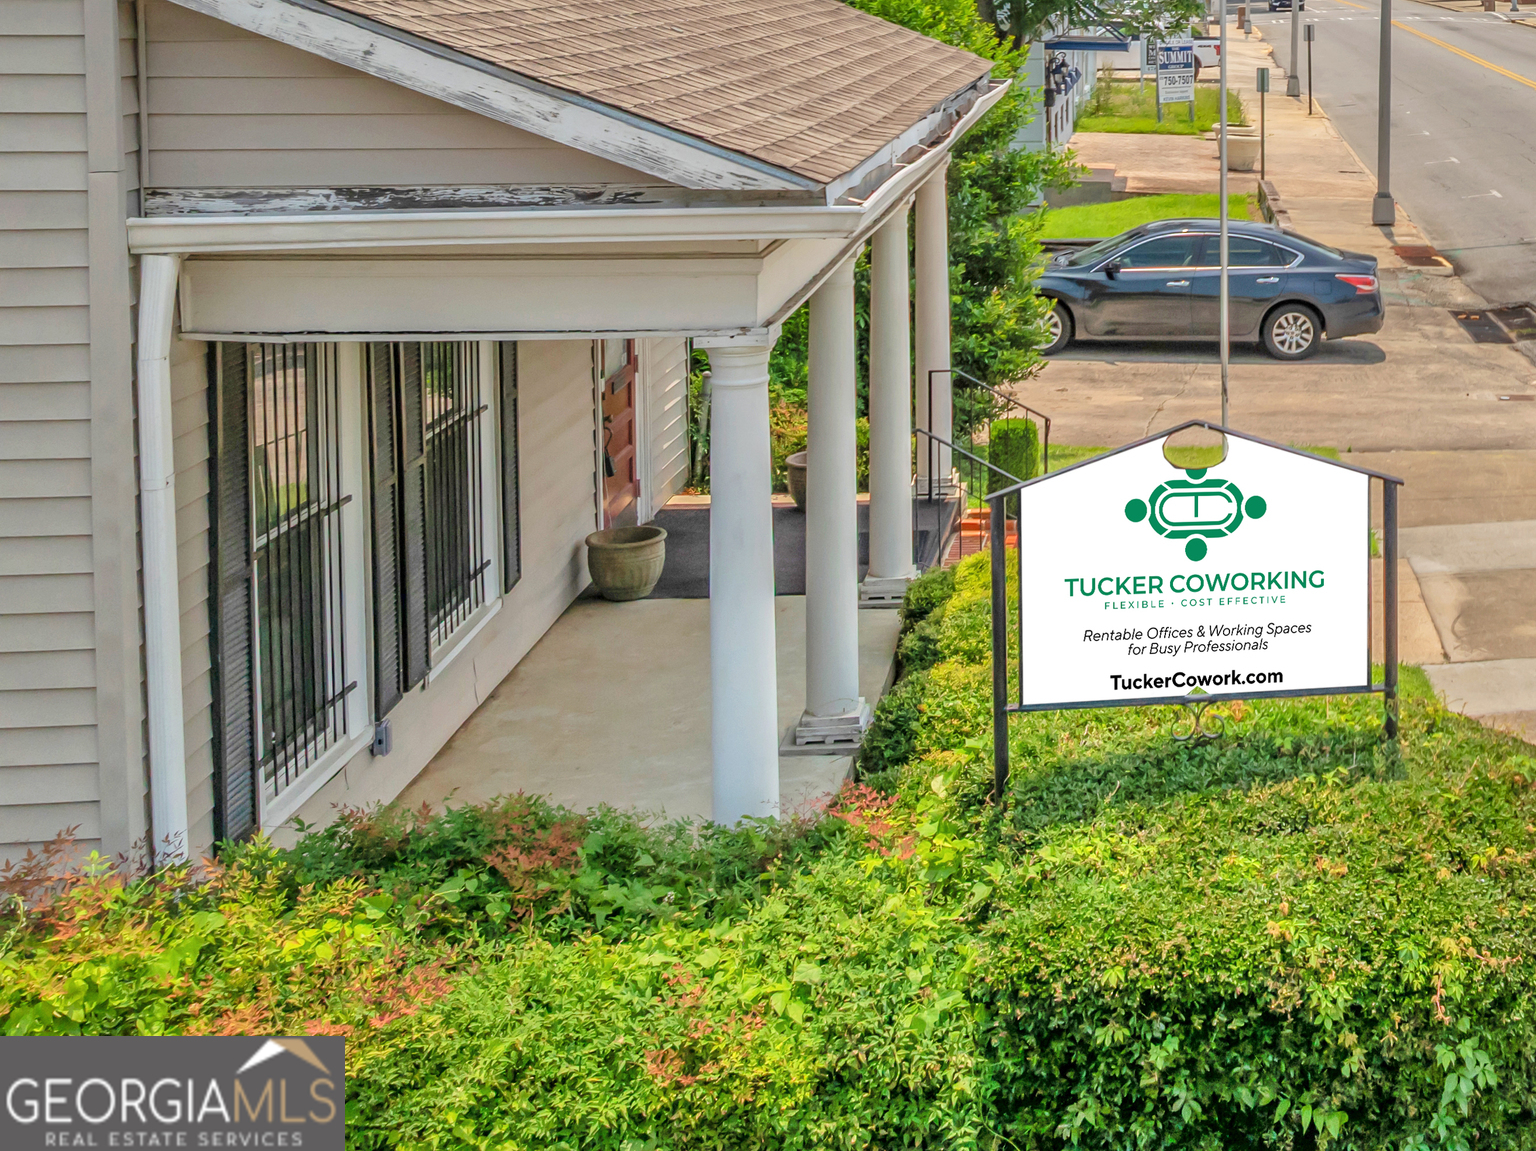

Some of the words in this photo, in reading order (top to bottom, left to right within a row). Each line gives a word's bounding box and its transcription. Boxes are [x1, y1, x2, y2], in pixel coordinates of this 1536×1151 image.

[1158, 50, 1193, 64] SUMMIT
[1164, 75, 1194, 86] 750-7507
[1064, 575, 1164, 597] TUCKER
[1169, 569, 1326, 594] COWORKING
[1104, 599, 1165, 610] FLEXIBLE
[1181, 597, 1213, 608] COST
[1219, 595, 1286, 607] EFFECTIVE
[1083, 628, 1143, 642] Rentable
[1147, 626, 1194, 640] Offices
[1196, 625, 1206, 638] &
[1209, 624, 1264, 639] Working
[1266, 623, 1312, 638] Spaces
[1128, 643, 1147, 656] for
[1150, 643, 1181, 657] Busy
[1183, 638, 1269, 654] Professionals
[1109, 670, 1284, 691] TuckerCowork.com
